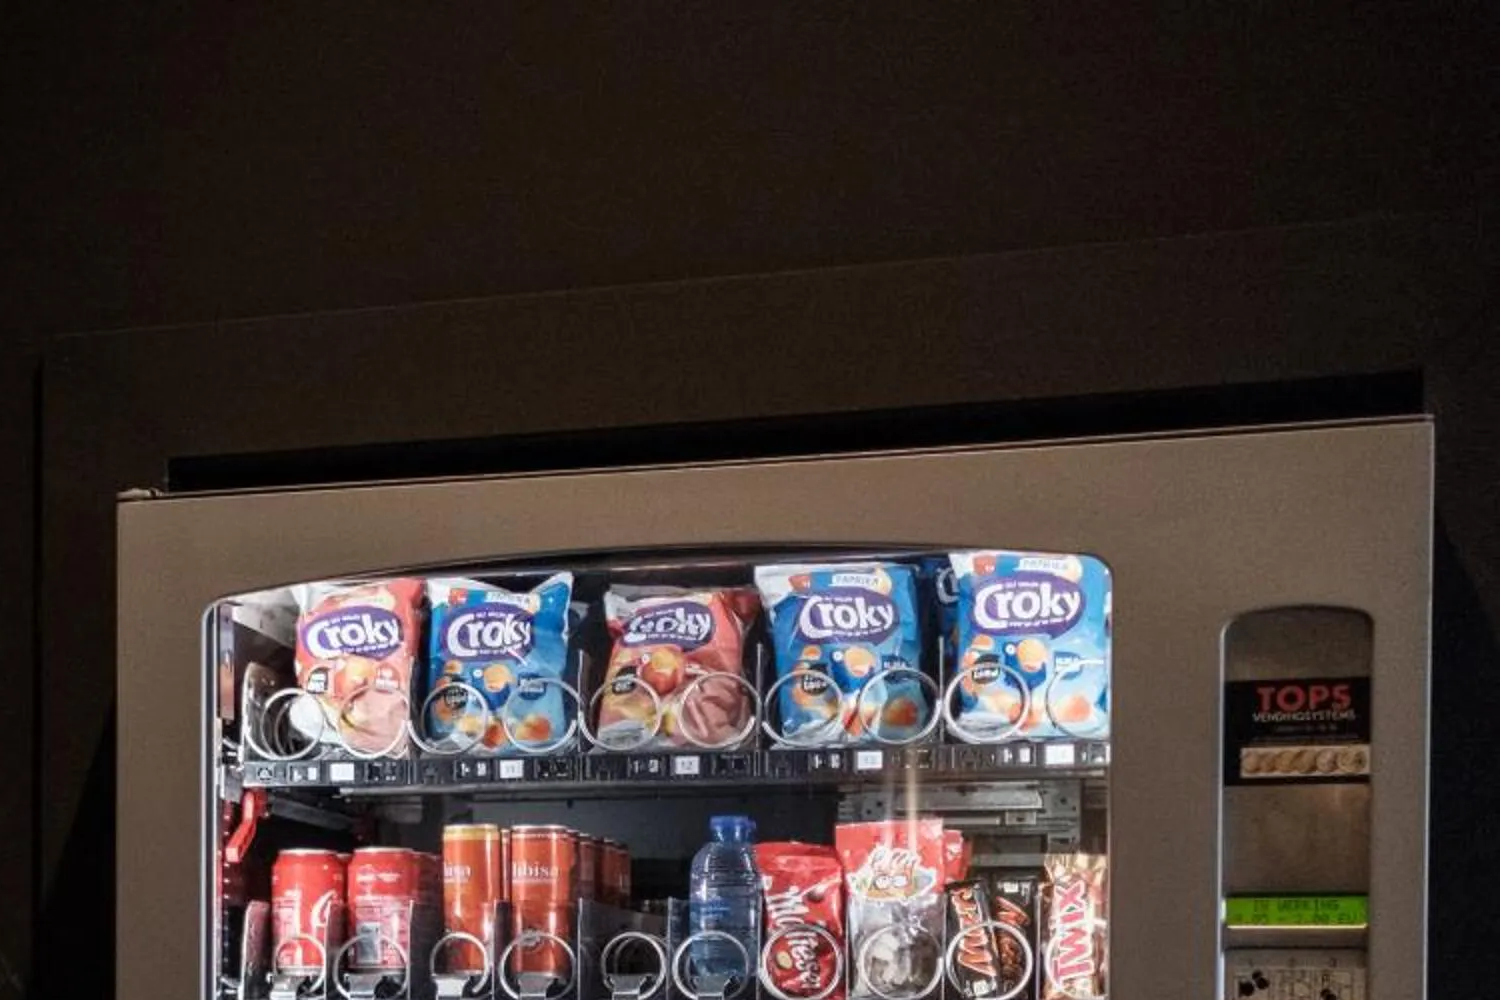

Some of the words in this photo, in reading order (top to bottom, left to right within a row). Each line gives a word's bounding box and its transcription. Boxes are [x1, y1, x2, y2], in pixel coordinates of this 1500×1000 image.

[799, 594, 894, 640] Croky
[974, 580, 1081, 630] Croky
[306, 613, 400, 661] Croky
[446, 611, 532, 657] Croky
[1256, 683, 1352, 713] TOPS
